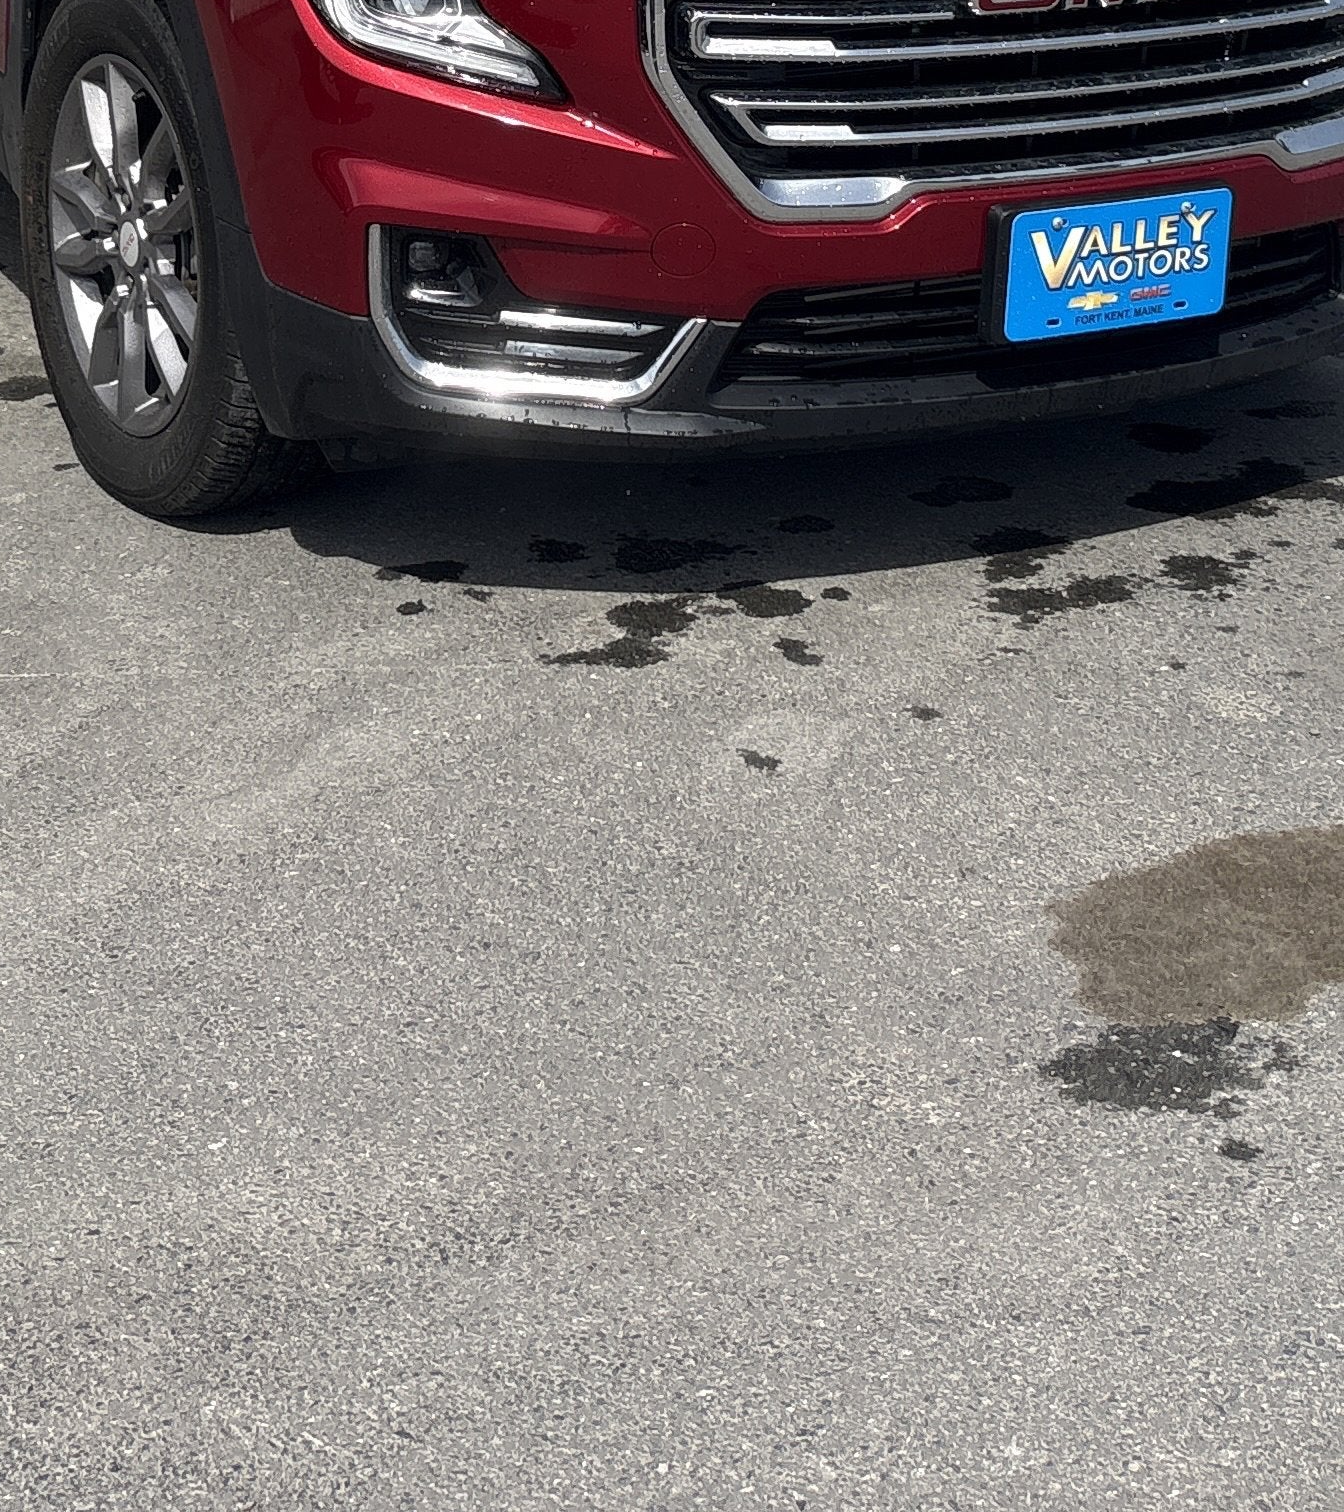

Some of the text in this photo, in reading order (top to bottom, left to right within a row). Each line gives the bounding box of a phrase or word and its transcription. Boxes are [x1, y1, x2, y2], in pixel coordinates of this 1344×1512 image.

[1030, 209, 1217, 289] VALLEY
[1067, 244, 1209, 287] MOTORS
[1075, 313, 1102, 325] FORT
[1133, 304, 1164, 317] MAINE
